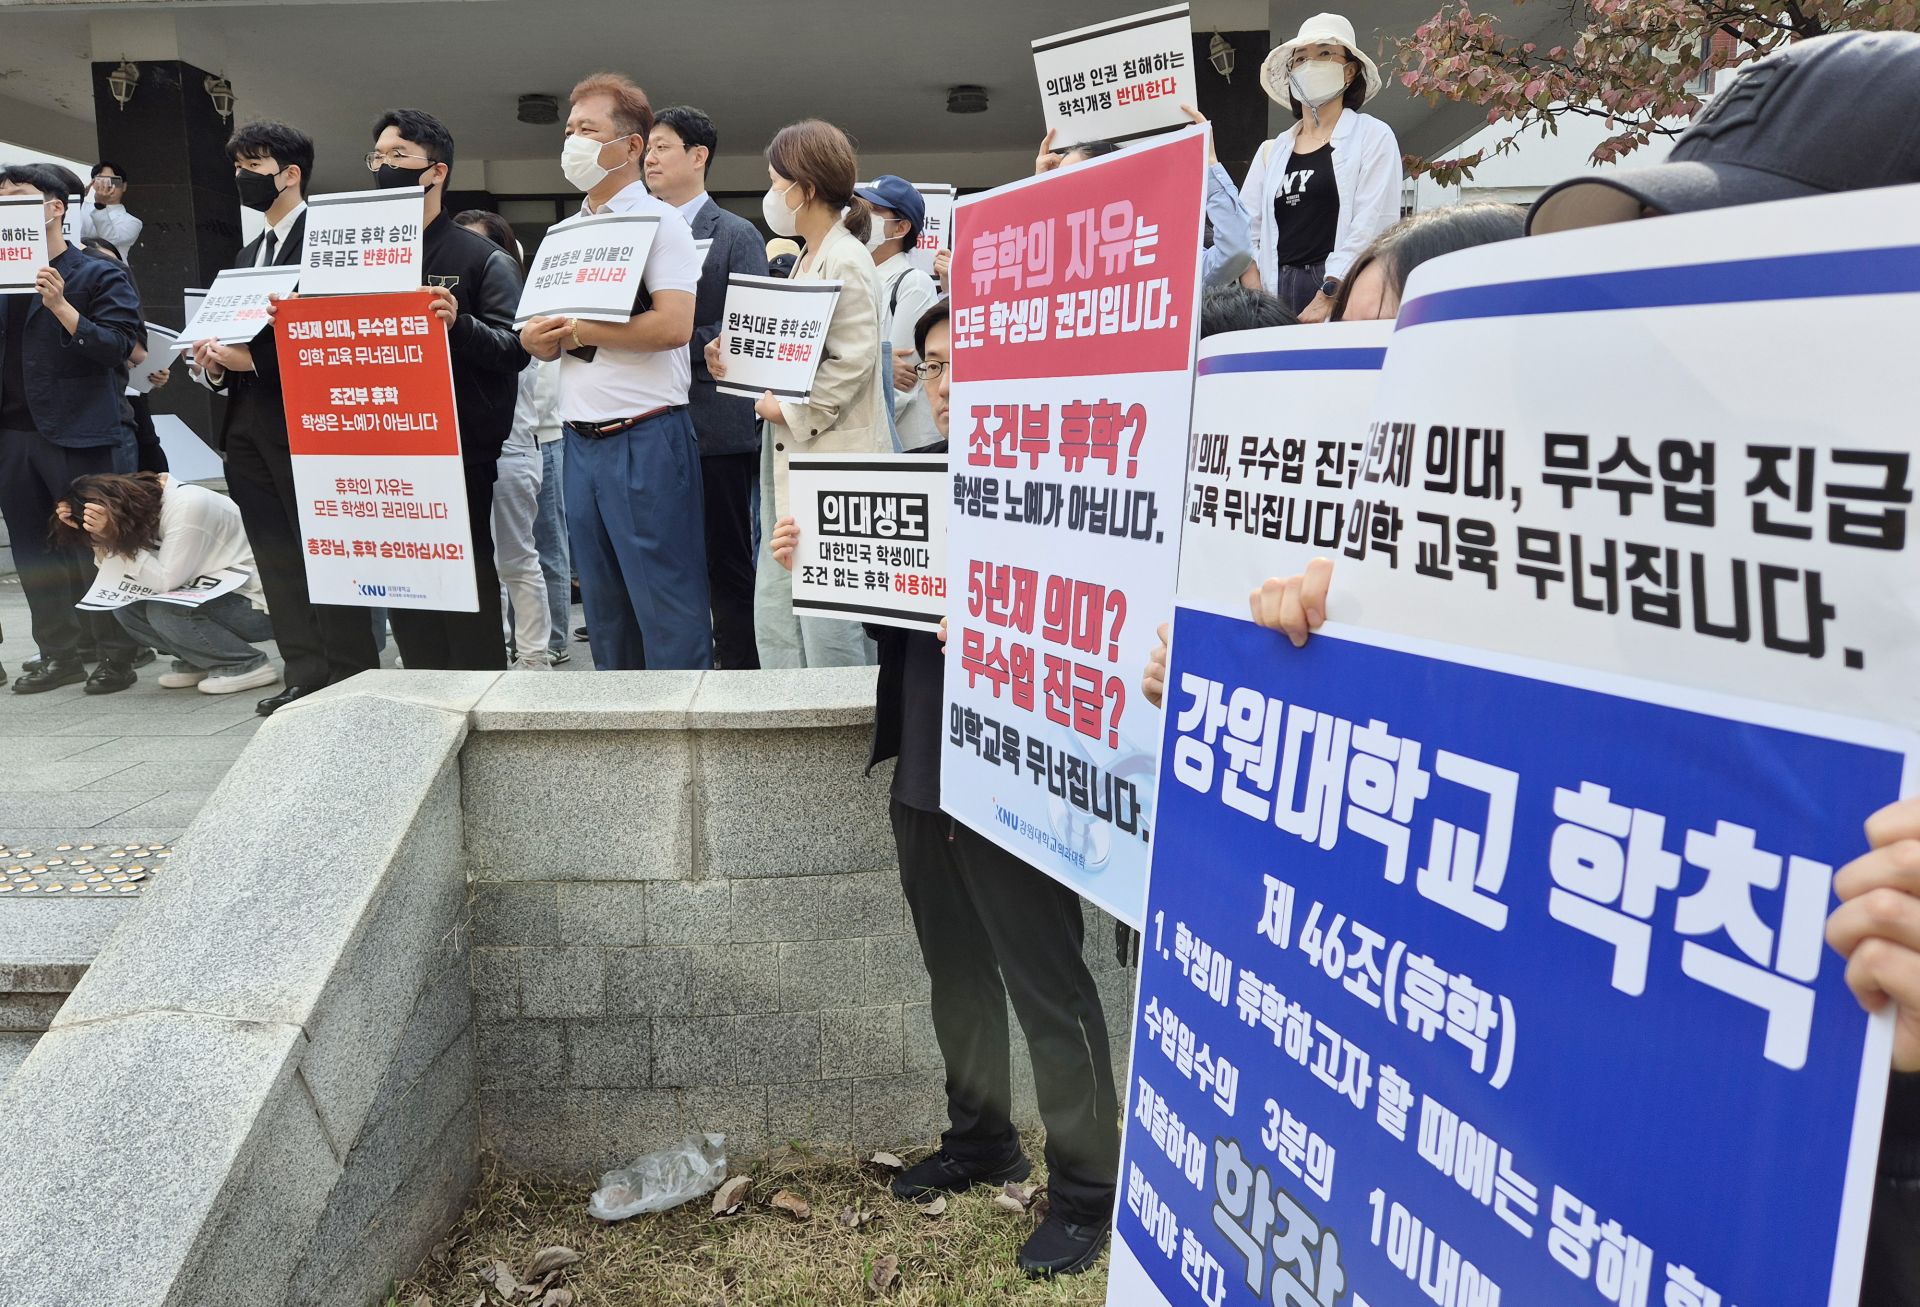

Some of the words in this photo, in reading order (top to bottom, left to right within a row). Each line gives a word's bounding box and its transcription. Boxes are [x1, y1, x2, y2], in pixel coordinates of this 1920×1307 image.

[1046, 72, 1086, 96] 의대생
[1090, 64, 1118, 87] 인권
[1123, 51, 1185, 79] 침해하는
[1058, 91, 1112, 117] 학칙개정
[1116, 77, 1177, 106] 반대한다
[309, 228, 356, 247] 원칙대로
[361, 226, 385, 244] 휴학
[389, 224, 417, 243] 승인!
[971, 218, 1055, 296] 휴학의
[1065, 200, 1158, 283] 자유는
[310, 250, 358, 268] 등록금도
[363, 246, 412, 266] 반환하라
[540, 249, 582, 271] 불법증원
[582, 246, 634, 263] 밀어붙인
[534, 271, 573, 290] 책임자는
[575, 267, 627, 284] 물러나라
[287, 320, 323, 340] 5년제
[324, 319, 356, 340] 의대,
[357, 317, 398, 337] 무수업
[400, 315, 429, 336] 진급
[728, 312, 778, 336] 원칙대로
[780, 318, 799, 339] 휴학
[800, 320, 822, 339] 승인!
[954, 305, 985, 349] 모든
[989, 296, 1049, 344] 학생의
[1055, 277, 1178, 339] 권리입니다.
[299, 348, 325, 366] 의학
[327, 346, 353, 366] 교육
[355, 344, 423, 365] 무너집니다
[730, 336, 776, 359] 등록금도
[777, 342, 813, 362] 반환하라
[329, 387, 369, 406] 조건부
[371, 386, 399, 405] 휴학
[301, 413, 338, 432] 학생은
[341, 413, 380, 432] 노예가
[382, 412, 438, 432] 아닙니다
[968, 403, 1050, 470] 조건부
[1059, 398, 1147, 479] 휴학?
[1197, 433, 1231, 482] 의대,
[1238, 436, 1306, 484] 무수업
[335, 478, 372, 496] 휴학의
[375, 478, 414, 496] 자유는
[1424, 424, 1522, 514] 의대,
[1541, 431, 1717, 527] 무수업
[1744, 443, 1914, 552] 진급
[314, 500, 338, 517] 모든
[340, 500, 378, 518] 학생의
[381, 501, 448, 520] 권리입니다
[821, 495, 925, 538] 의대생도
[953, 473, 999, 519] 학생은
[1004, 480, 1064, 528] 노예가
[1068, 485, 1164, 544] 아닙니다.
[1189, 483, 1219, 528] 교육
[1224, 488, 1345, 549] 무너집니다
[307, 538, 350, 559] 총장님,
[352, 540, 377, 558] 휴학
[380, 541, 464, 561] 승인하십시오!
[819, 541, 871, 565] 대한민국
[876, 544, 930, 569] 학생이다
[118, 581, 158, 596] 대한민
[358, 584, 386, 597] KNU
[802, 565, 828, 586] 조건
[834, 567, 859, 589] 없는
[864, 570, 889, 592] 휴학
[1343, 499, 1403, 569] 의학
[1415, 511, 1499, 591] 교육
[1515, 525, 1865, 671] 무너집니다.
[967, 559, 1039, 635] 5년제
[1042, 574, 1127, 663] 의대?
[962, 627, 1035, 712] 무수업
[1043, 653, 1126, 750] 진급?
[950, 702, 1020, 776] 의학교육
[1026, 735, 1150, 843] 무너집니다.
[995, 804, 1019, 831] KNU
[1172, 671, 1520, 931] 강원대학교
[1547, 779, 1833, 1071] 학칙
[1257, 872, 1296, 950] 제
[1144, 996, 1240, 1117] 수업일수의
[1261, 1097, 1336, 1202] 3분의
[1154, 909, 1170, 961] 1.
[1174, 920, 1233, 1008] 학생이
[1236, 968, 1373, 1110] 휴학하고자
[1376, 1064, 1415, 1142] 할
[1417, 1093, 1539, 1239] 때에는
[1547, 1184, 1654, 1307] 당해
[1135, 1075, 1208, 1192] 제출하여
[1127, 1159, 1179, 1261] 받아야
[1181, 1226, 1227, 1307] 한다
